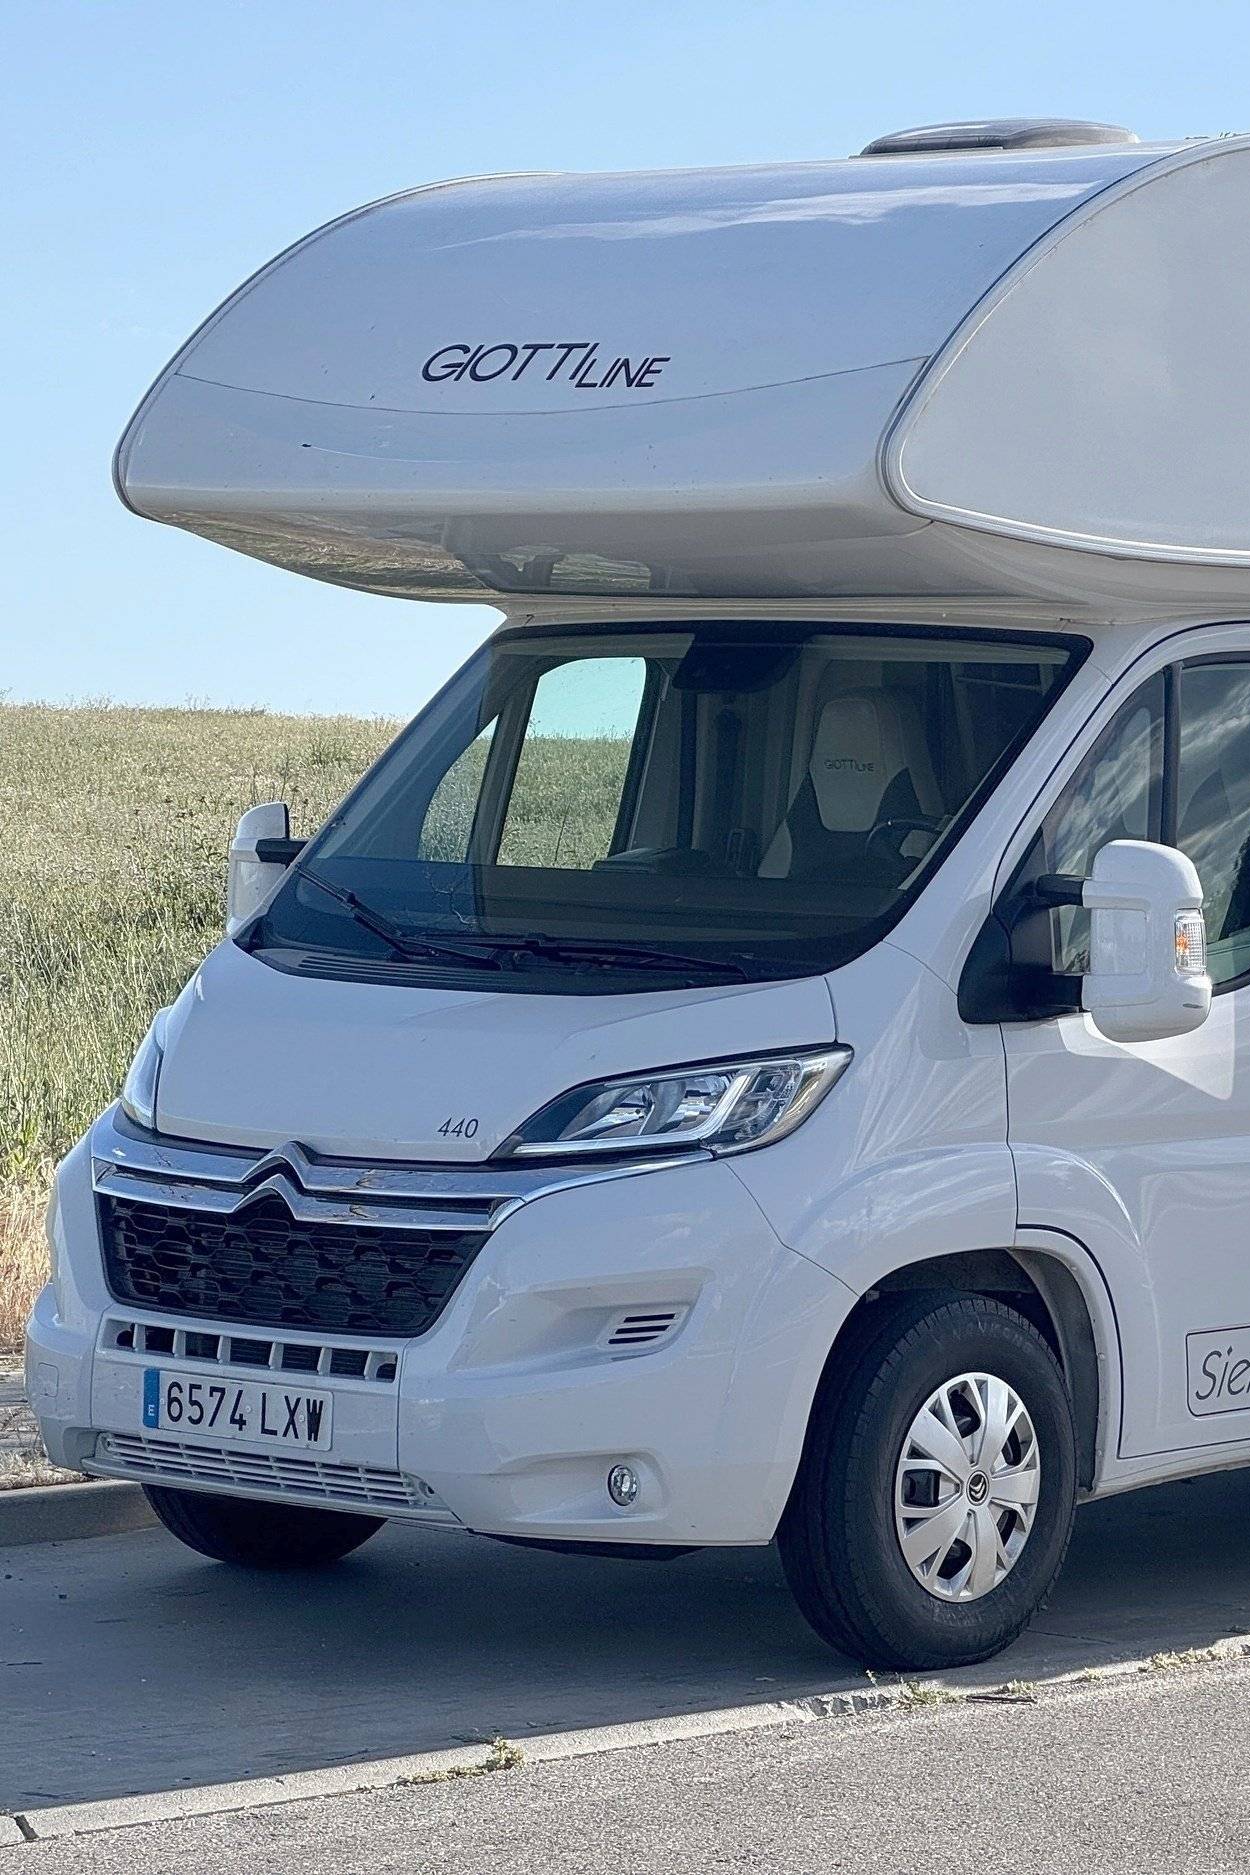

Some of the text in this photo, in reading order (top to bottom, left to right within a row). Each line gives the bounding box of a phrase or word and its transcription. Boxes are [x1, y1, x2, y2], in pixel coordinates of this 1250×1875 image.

[437, 1117, 479, 1138] 440
[147, 1404, 155, 1417] E
[167, 1381, 325, 1442] 6574 LXW
